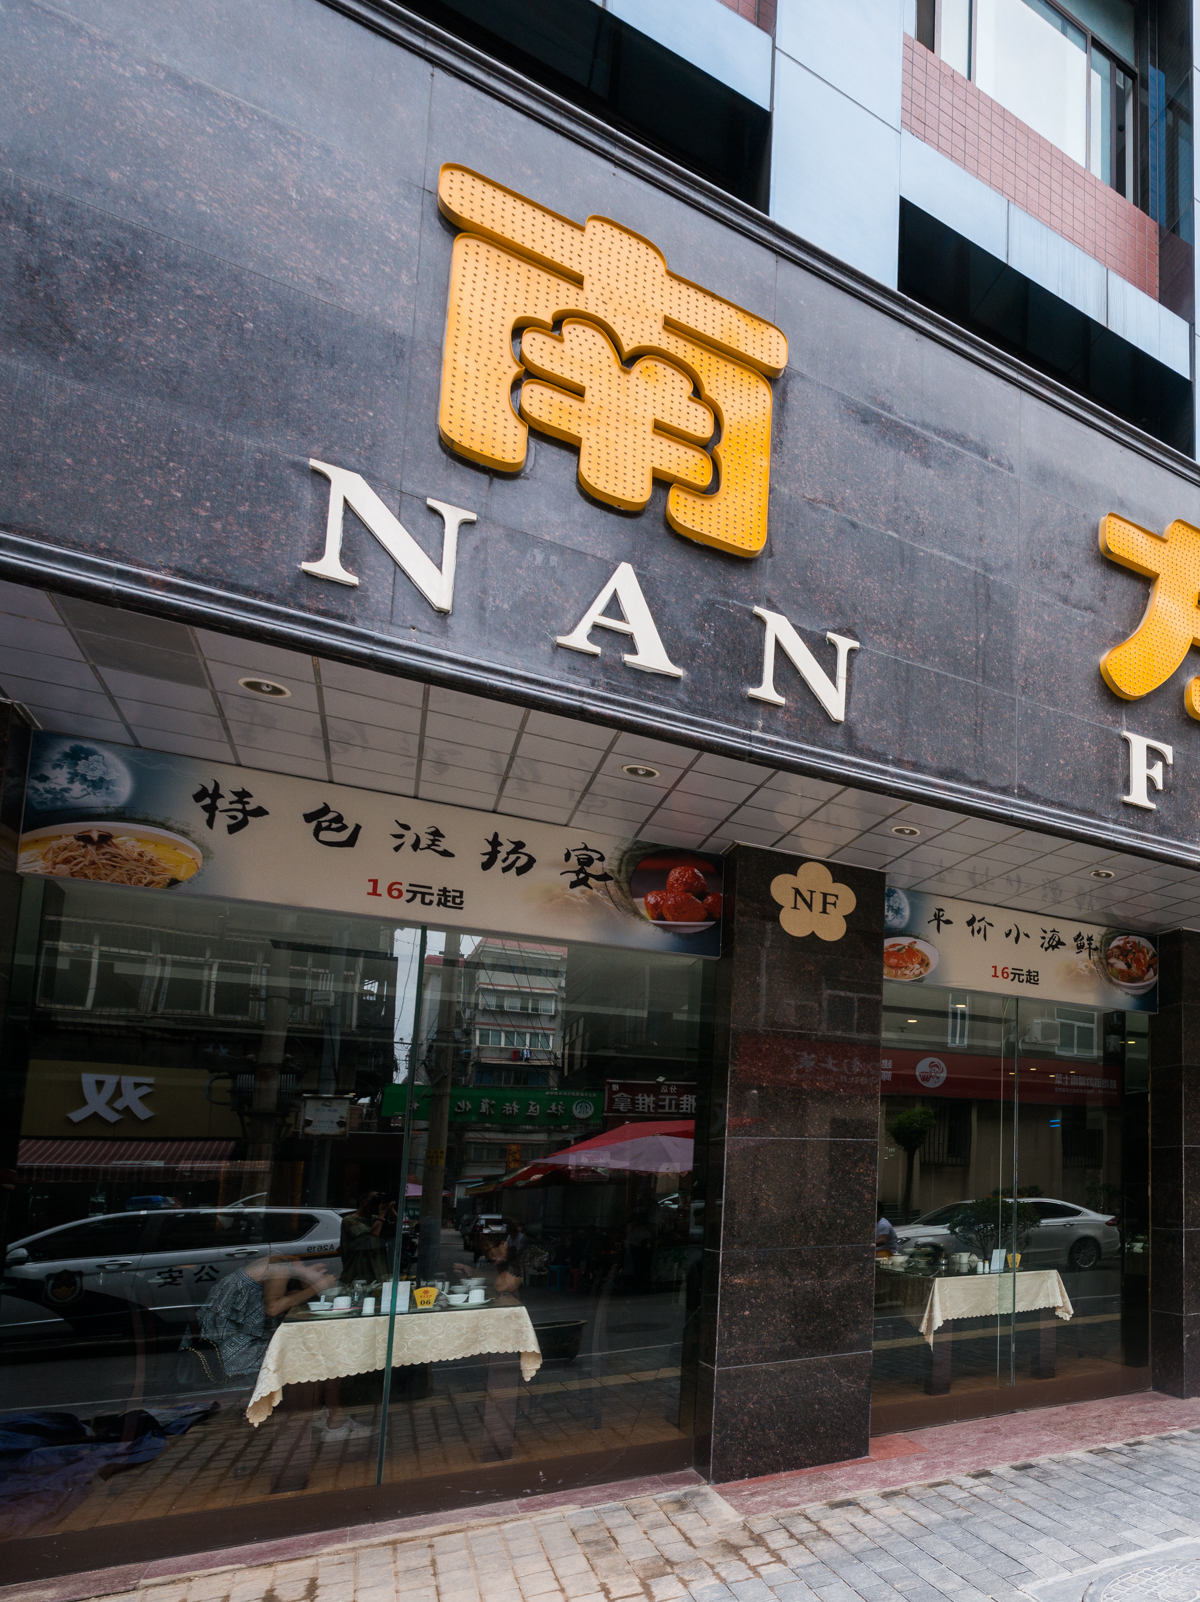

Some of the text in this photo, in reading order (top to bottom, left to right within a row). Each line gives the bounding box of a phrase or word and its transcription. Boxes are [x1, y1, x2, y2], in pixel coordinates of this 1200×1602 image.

[300, 458, 860, 723] NAN
[192, 779, 614, 890] 特色淮扬宴
[366, 878, 465, 911] 16元起
[791, 887, 840, 916] NF
[927, 907, 1100, 960] 平价小海鲜
[991, 965, 1040, 986] 16元起
